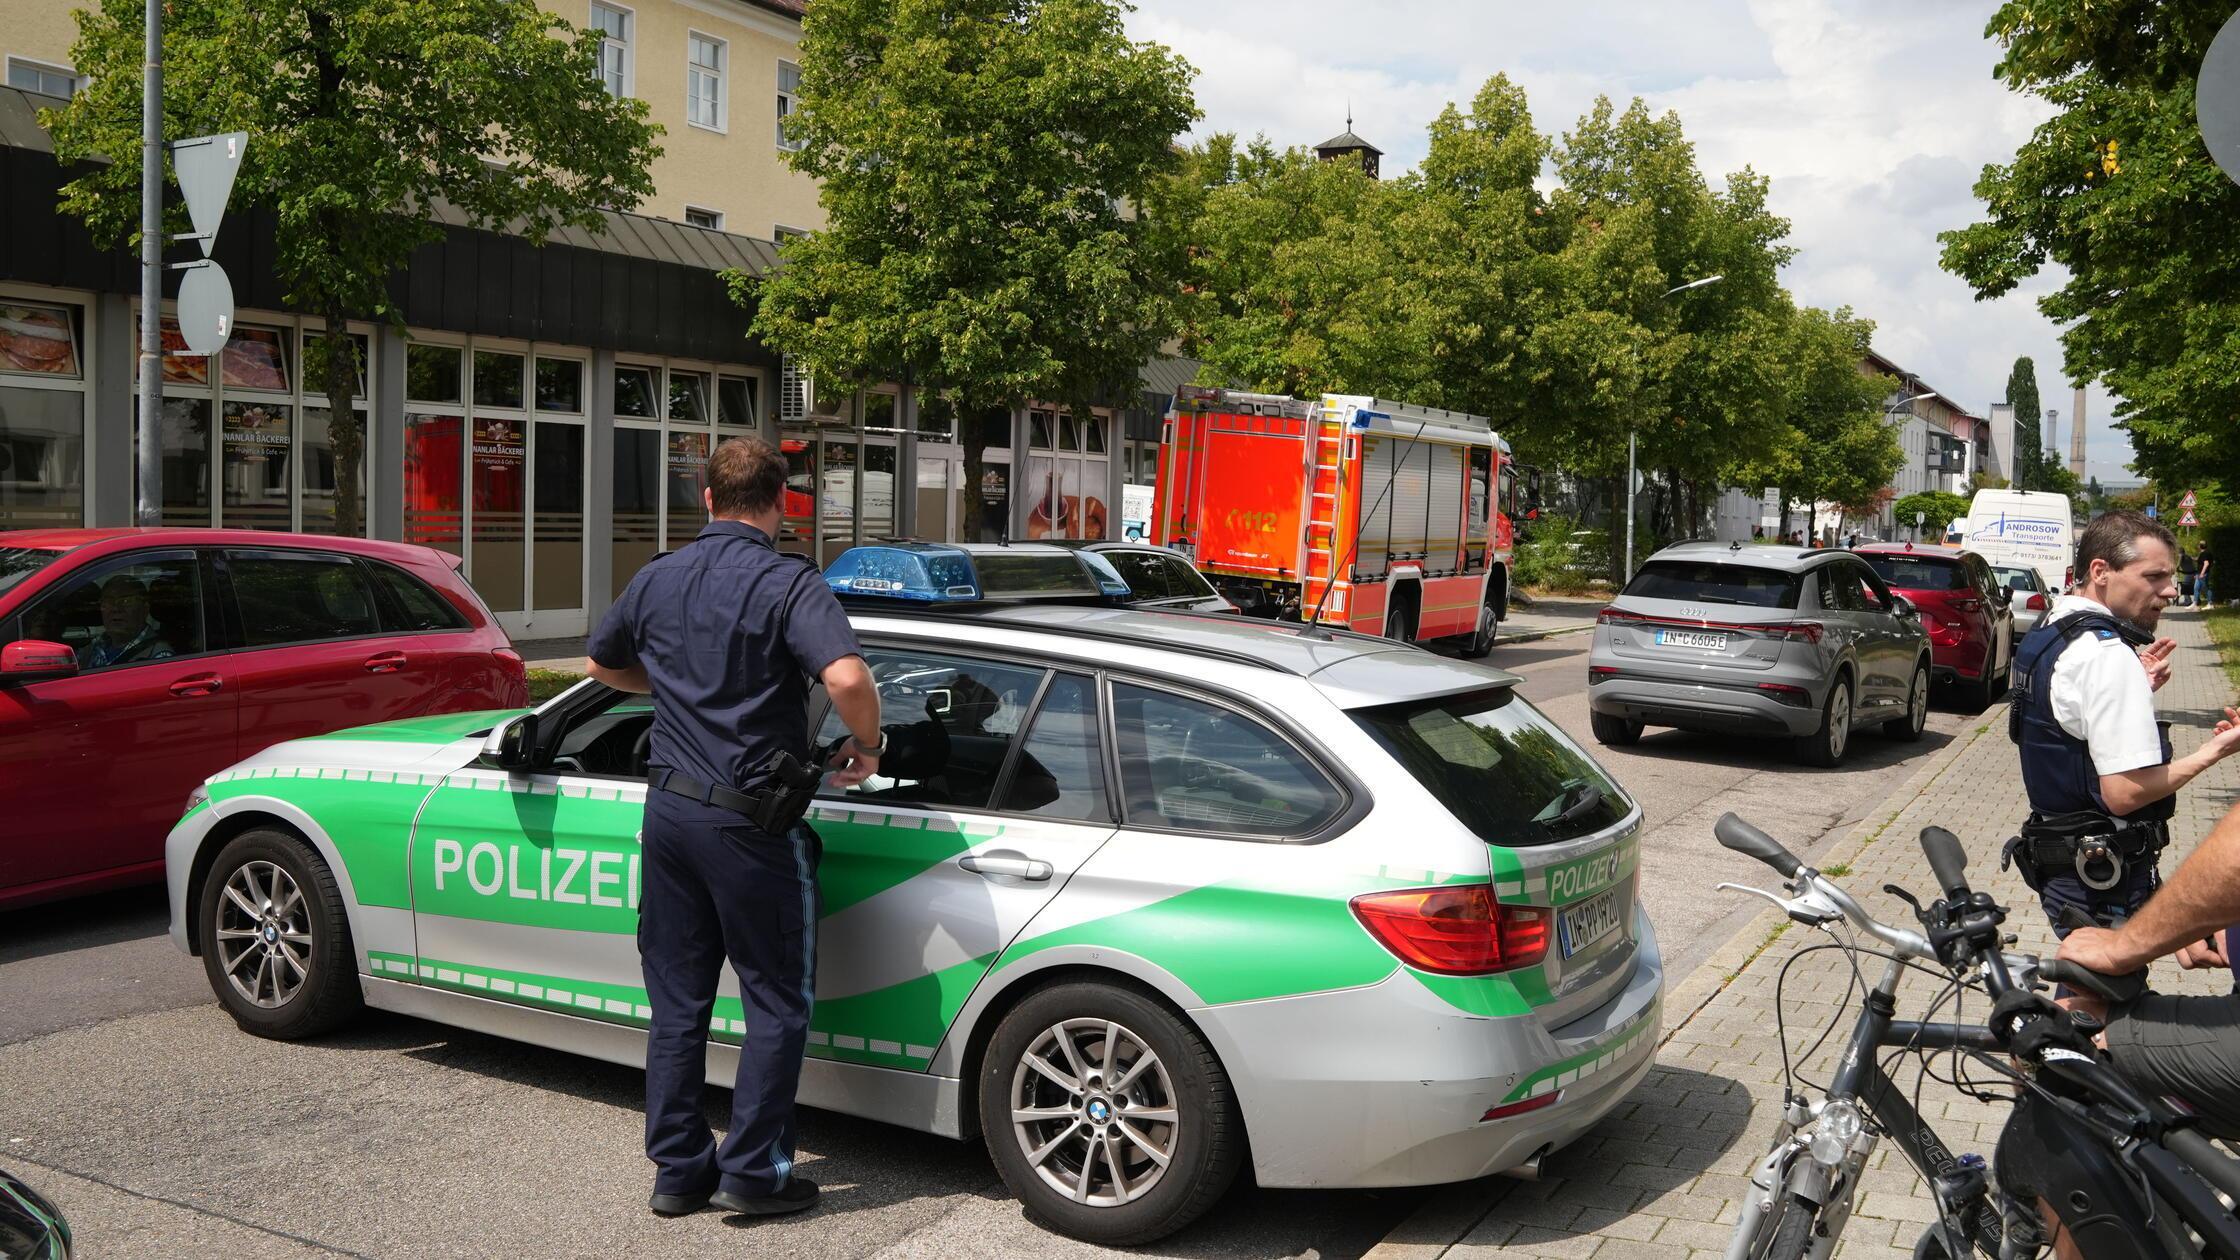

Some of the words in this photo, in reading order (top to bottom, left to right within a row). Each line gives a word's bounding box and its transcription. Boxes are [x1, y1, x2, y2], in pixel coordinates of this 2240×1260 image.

[1243, 511, 1278, 532] 112
[2005, 523, 2060, 534] ANDROSOW
[2012, 532, 2055, 542] Transporte
[434, 839, 640, 909] POLIZEI
[1550, 855, 1611, 902] POLIZEI
